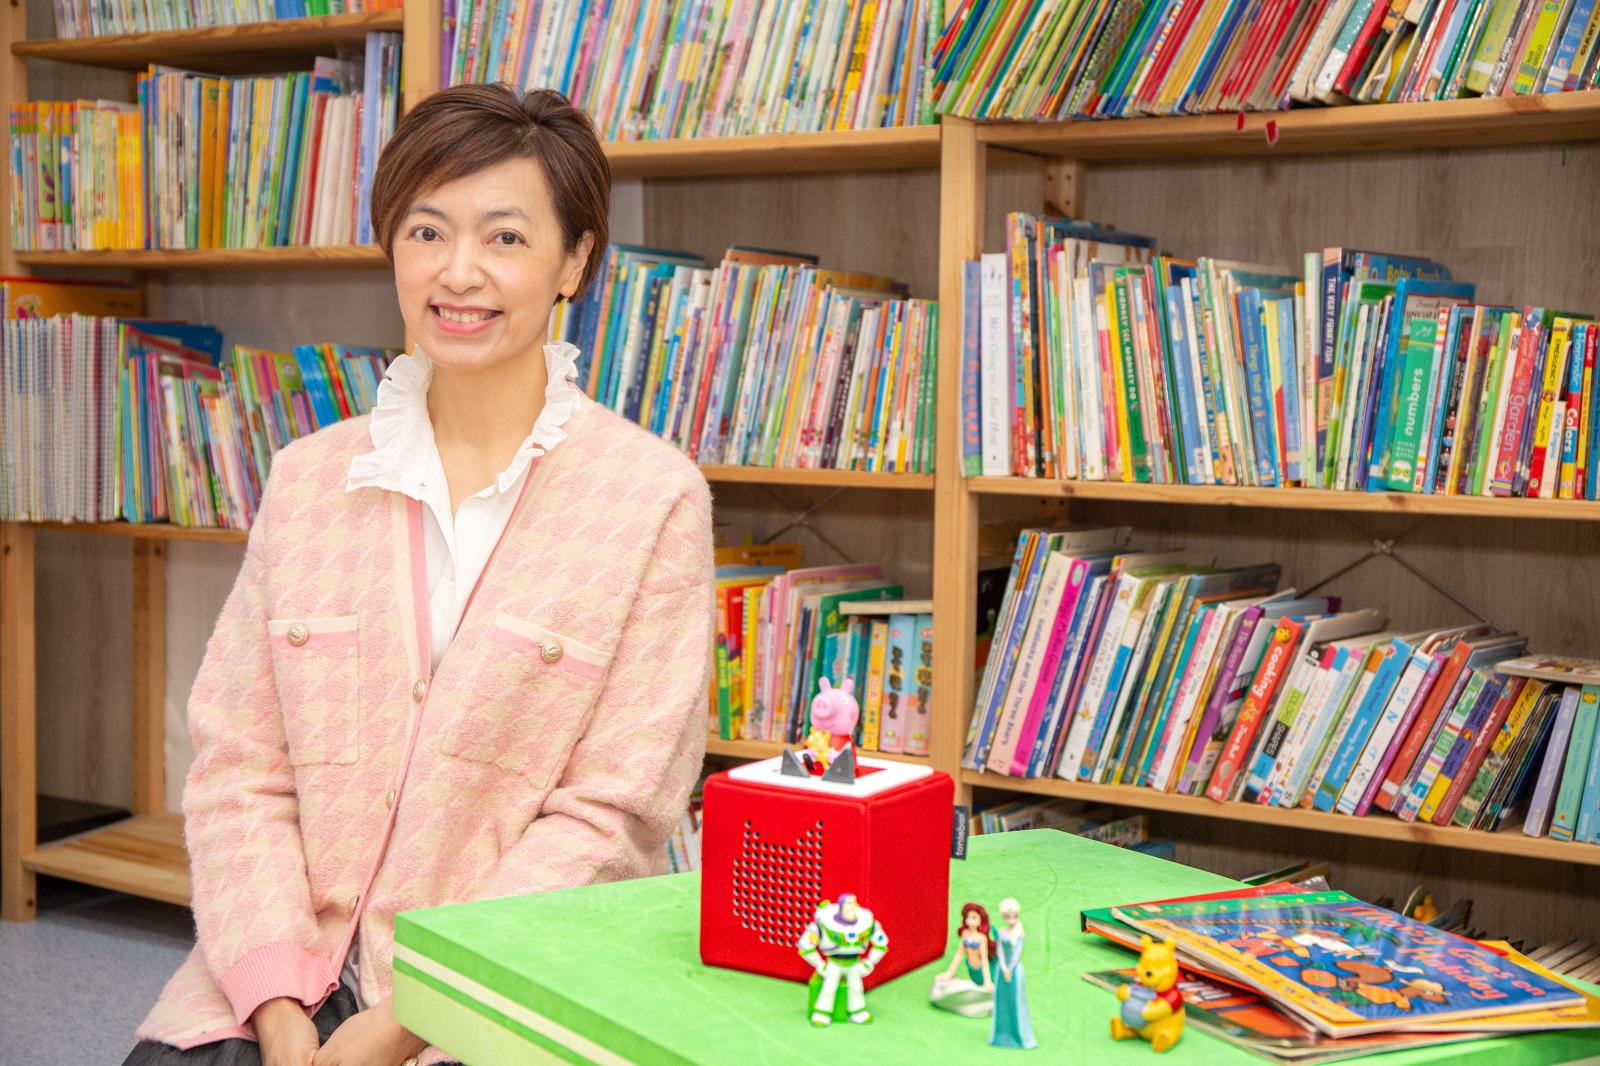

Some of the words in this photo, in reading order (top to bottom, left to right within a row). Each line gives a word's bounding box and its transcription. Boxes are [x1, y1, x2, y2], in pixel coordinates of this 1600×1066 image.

[1327, 277, 1336, 294] THE
[1326, 294, 1335, 316] VERY
[1325, 317, 1334, 343] FUNNY
[1324, 345, 1333, 363] FISH
[1547, 338, 1561, 386] EMERGENCY!
[1402, 367, 1425, 436] numbers
[1500, 393, 1526, 452] garden
[1563, 407, 1578, 453] Colors
[1026, 617, 1047, 660] Goldilocks
[1016, 679, 1028, 694] the
[1020, 661, 1033, 678] and
[1249, 642, 1286, 700] cooking
[1008, 695, 1023, 720] Three
[1279, 688, 1302, 725] COLORS
[1000, 721, 1015, 746] Bears
[1265, 722, 1287, 756] SHAPES
[955, 811, 966, 857] toniebox
[1397, 946, 1510, 1001] Holiday
[1448, 946, 1516, 980] Goes
[1511, 979, 1546, 996] on
